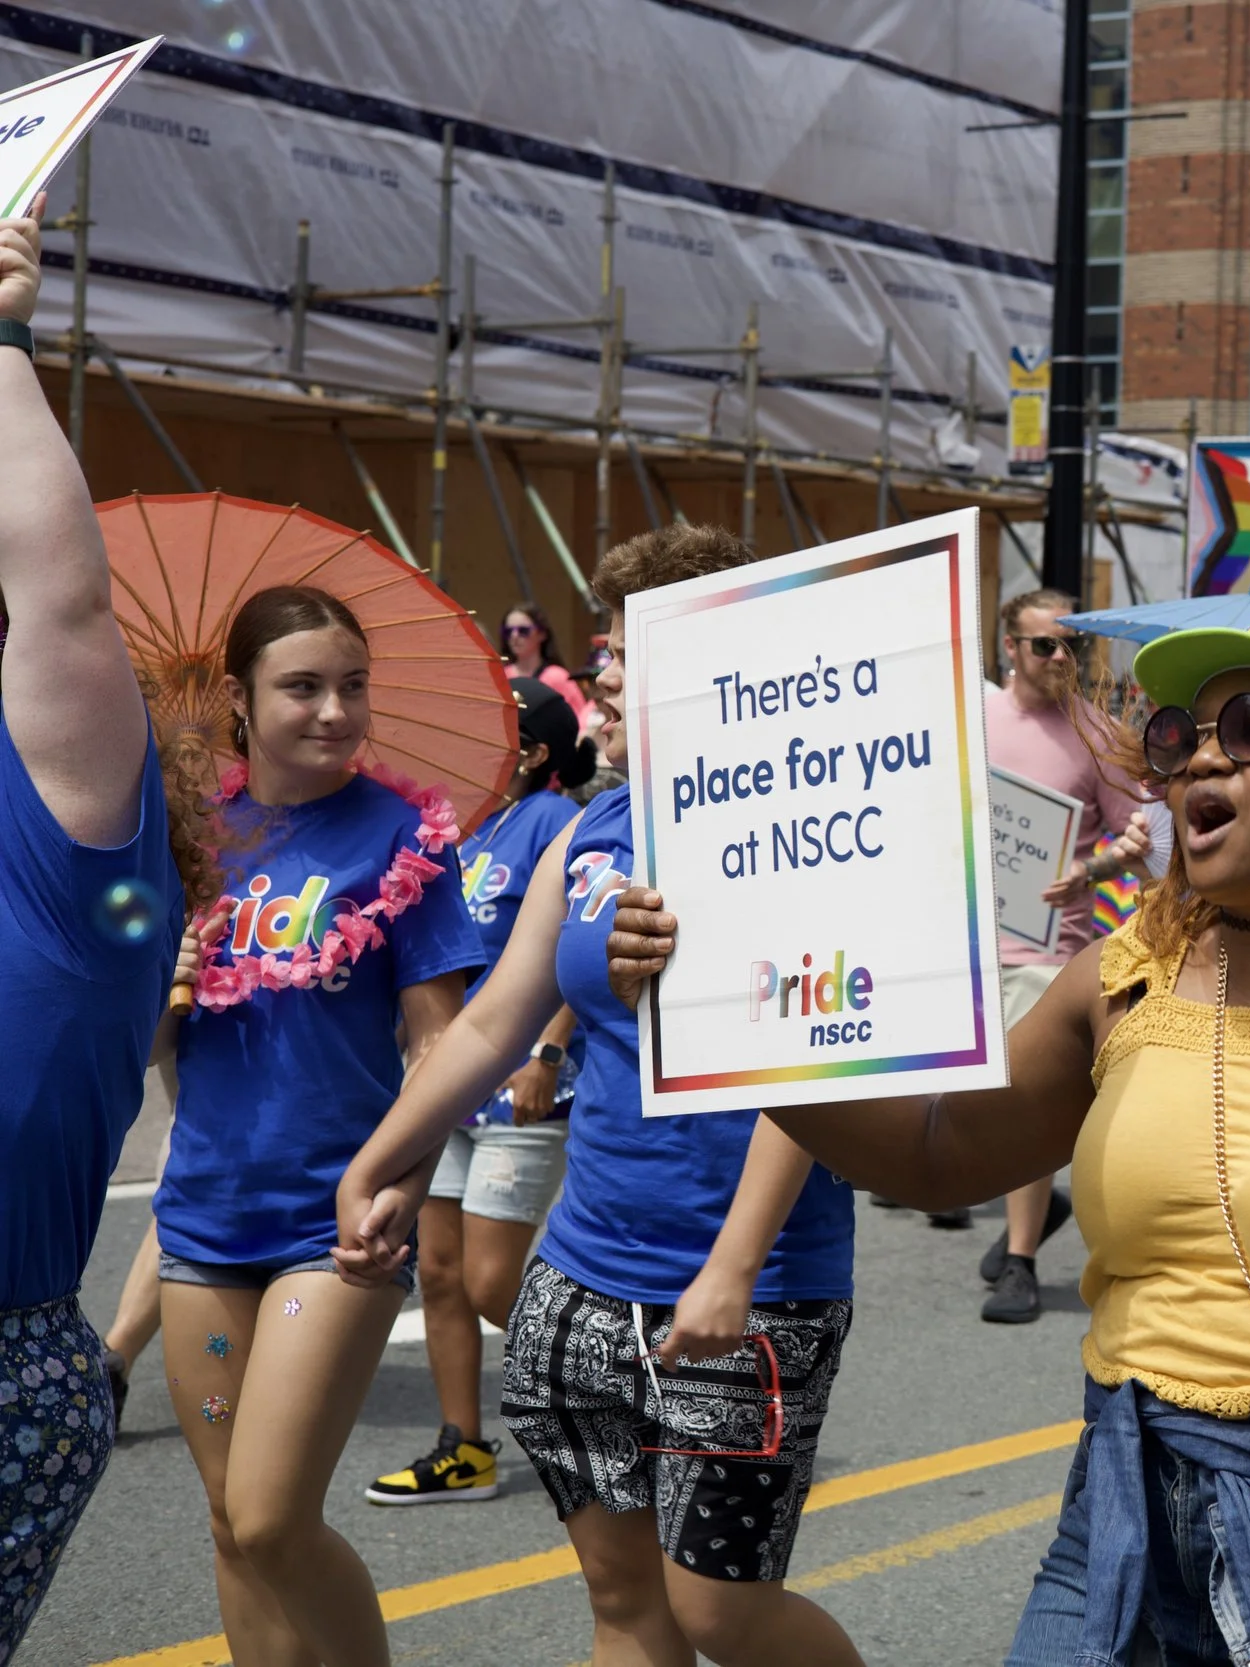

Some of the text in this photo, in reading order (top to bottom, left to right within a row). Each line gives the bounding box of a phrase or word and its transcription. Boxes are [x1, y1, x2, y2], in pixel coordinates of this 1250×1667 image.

[0, 115, 46, 144] le
[713, 655, 878, 725] There's a
[673, 730, 931, 823] place for you
[722, 806, 884, 879] at NSCC
[1018, 816, 1031, 829] a
[1014, 838, 1048, 861] you
[750, 950, 873, 1022] Pride
[810, 1020, 872, 1047] nscc
